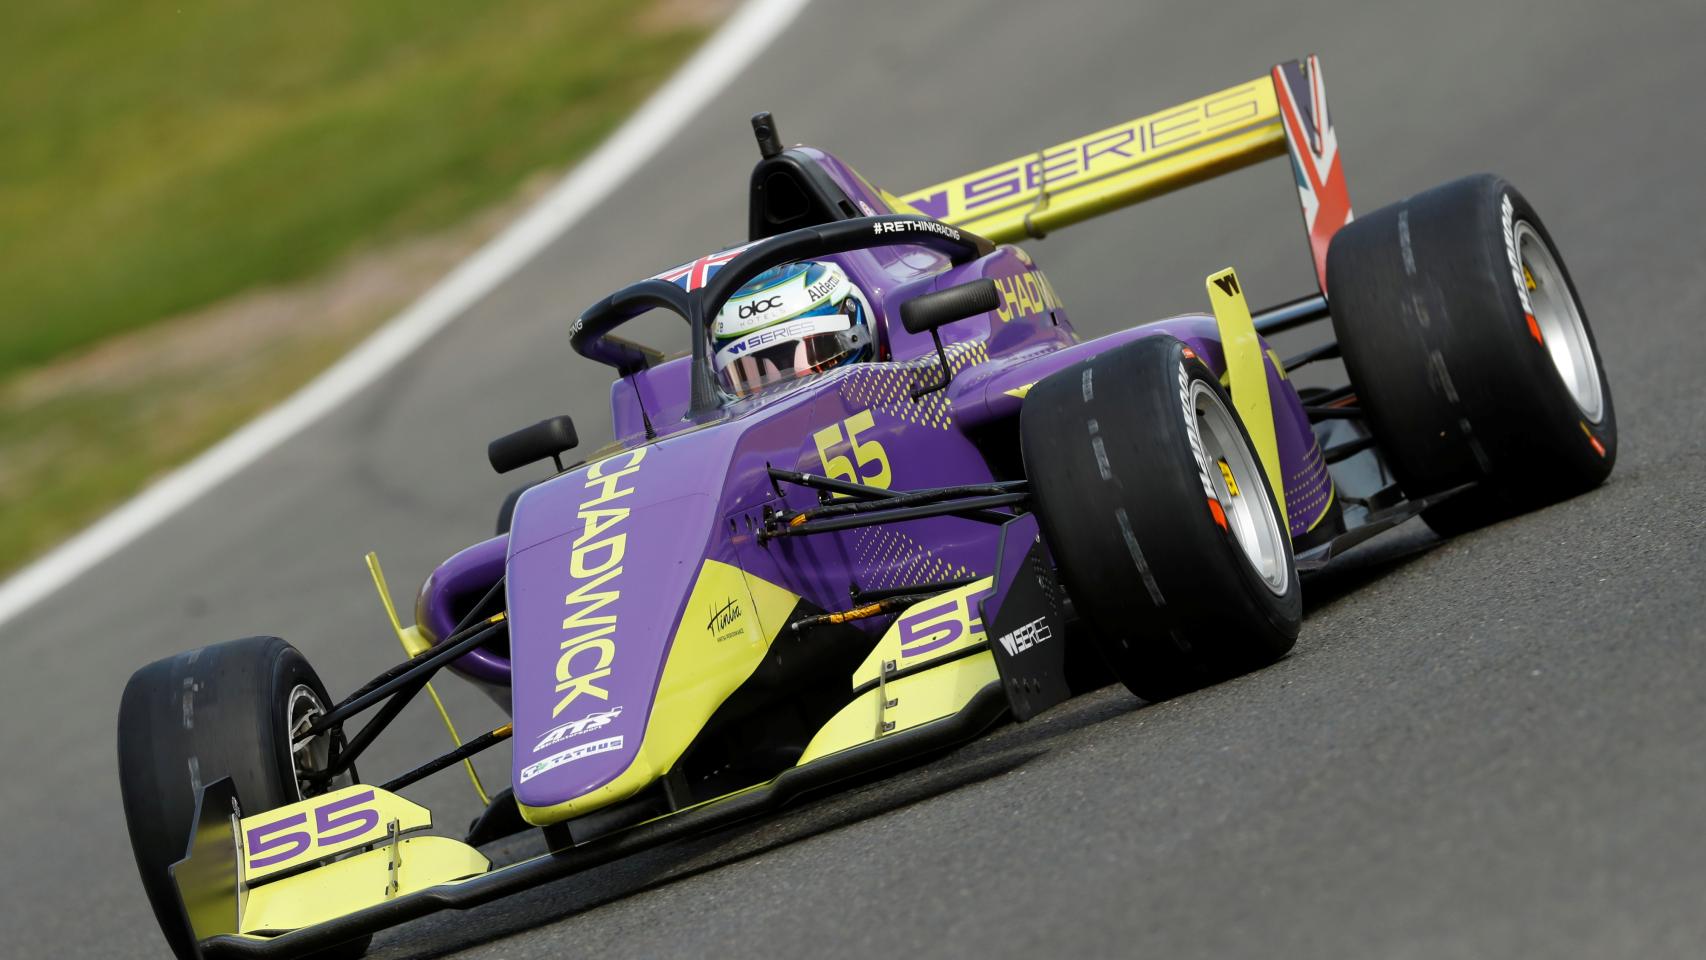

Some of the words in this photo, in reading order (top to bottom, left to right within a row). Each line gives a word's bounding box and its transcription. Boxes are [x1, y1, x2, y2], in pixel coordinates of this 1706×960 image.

[964, 87, 1257, 211] SERIES
[873, 221, 960, 240] #RETHINKRACING
[738, 295, 784, 319] bloc
[1213, 273, 1240, 297] W
[813, 408, 892, 499] 55
[553, 447, 647, 718] CHADWICK
[247, 790, 379, 869] 55
